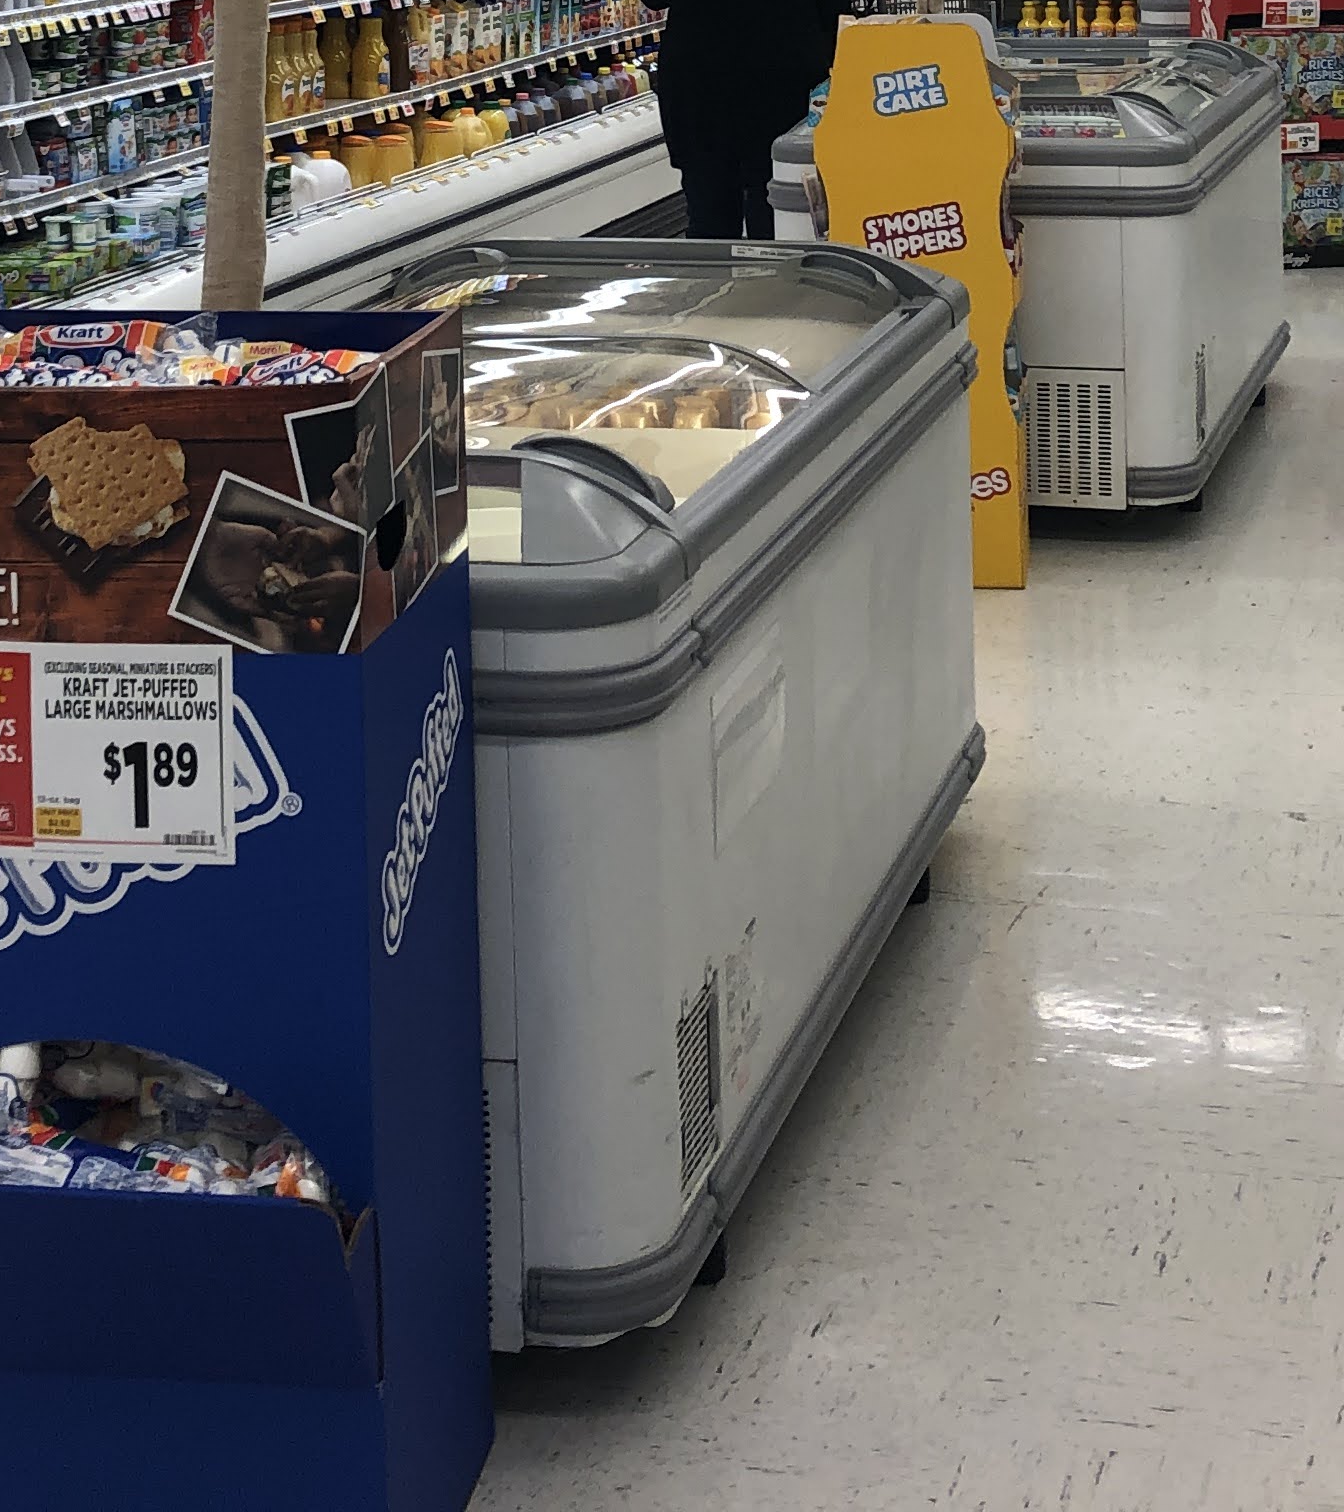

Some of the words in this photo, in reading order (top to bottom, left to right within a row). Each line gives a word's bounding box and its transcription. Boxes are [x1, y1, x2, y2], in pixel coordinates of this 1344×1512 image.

[1309, 59, 1334, 70] RICE
[876, 67, 940, 97] DIRT
[1297, 70, 1344, 83] KRISPIES
[876, 85, 946, 115] CAKE
[1304, 187, 1329, 198] RICE
[1292, 198, 1339, 210] KRISPIES
[865, 202, 961, 241] S'MORES
[57, 324, 105, 340] Kraft
[62, 677, 108, 697] KRAFT
[113, 677, 198, 698] JET-PUFFED
[45, 699, 91, 720] LARGE
[95, 699, 217, 721] MARSHMALLOWS
